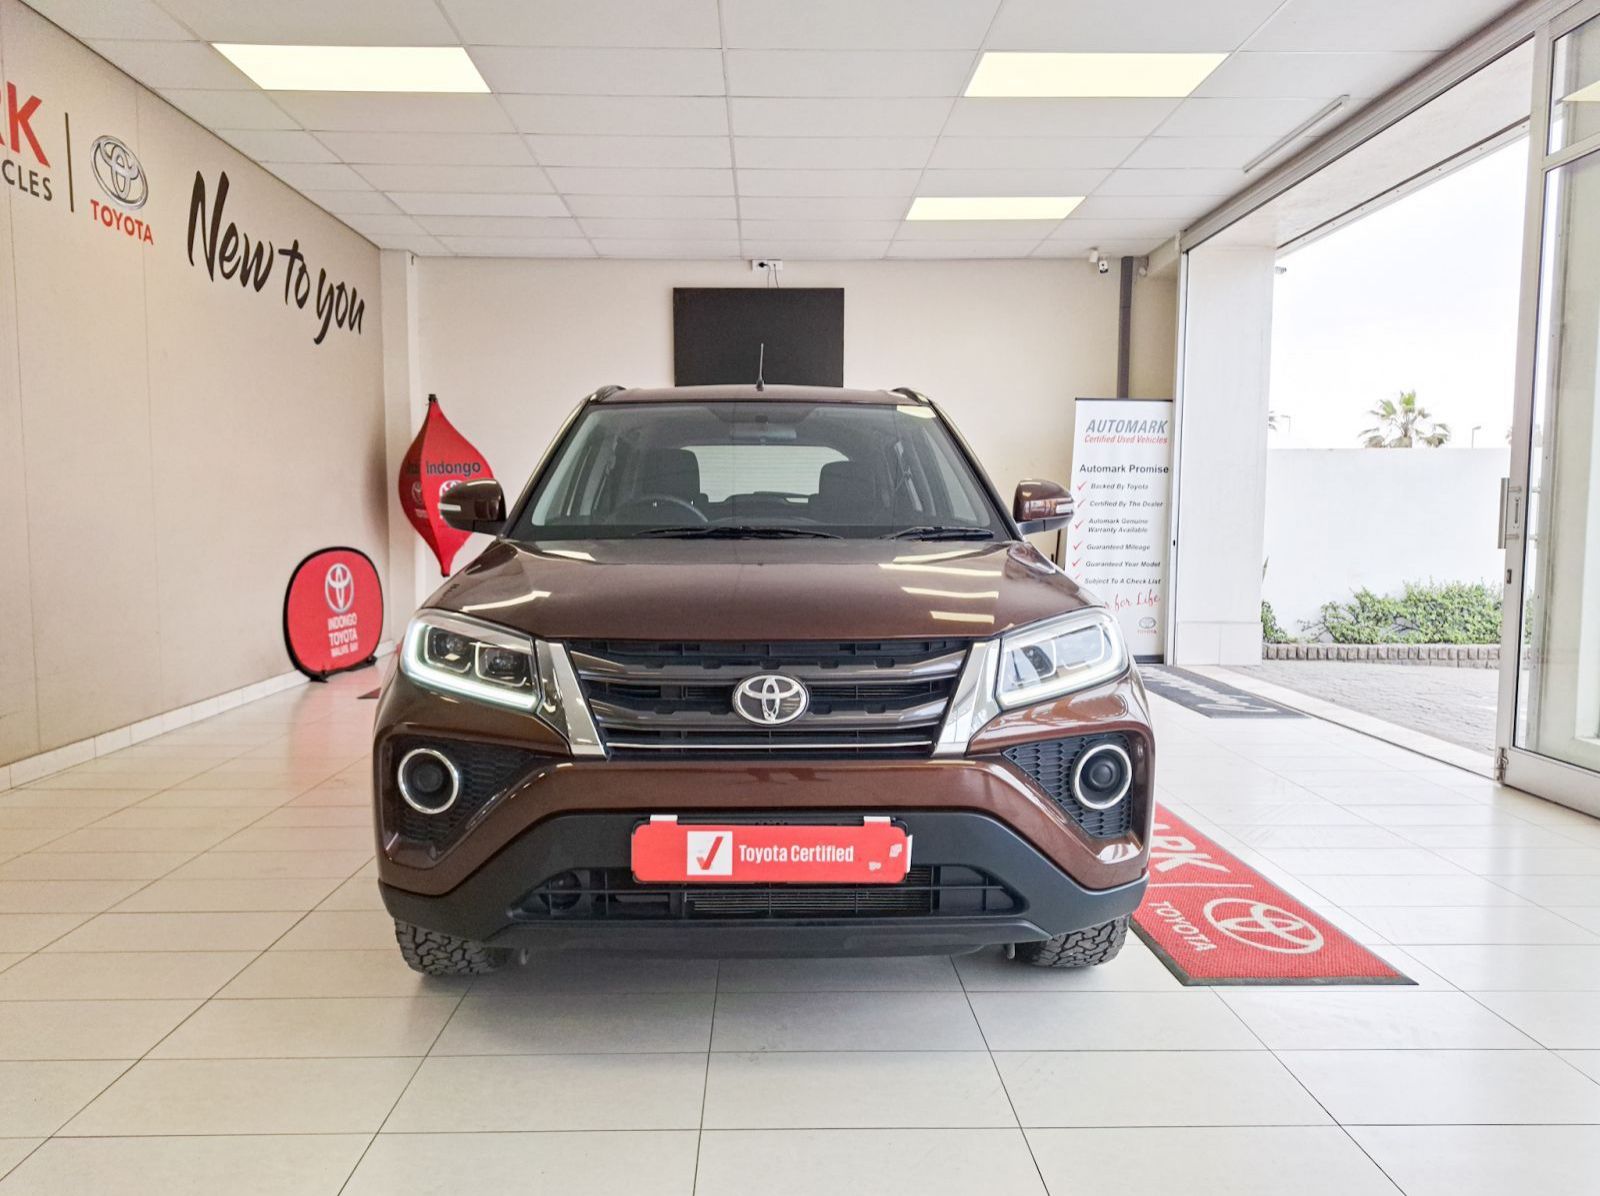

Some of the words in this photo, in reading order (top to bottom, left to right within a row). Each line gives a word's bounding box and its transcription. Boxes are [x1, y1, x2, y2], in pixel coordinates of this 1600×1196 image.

[0, 81, 51, 168] K
[1, 159, 53, 201] CLES
[90, 199, 154, 245] TOYOTA
[187, 170, 274, 292] New
[278, 239, 310, 309] to
[313, 268, 365, 345] you
[1086, 419, 1168, 434] AUTOMARK
[1084, 434, 1115, 444] Certified
[1117, 435, 1135, 444] Used
[1137, 435, 1168, 445] Vehicles
[1080, 464, 1126, 473] Automark
[1129, 464, 1169, 474] Promise
[1117, 483, 1124, 491] By
[1127, 483, 1149, 491] Toyota
[1085, 578, 1109, 586] Subject
[1114, 593, 1131, 611] for
[329, 628, 358, 647] TOYOTA
[739, 845, 788, 864] Toyota
[791, 845, 854, 862] Certified
[1148, 900, 1217, 951] TOYOTA
